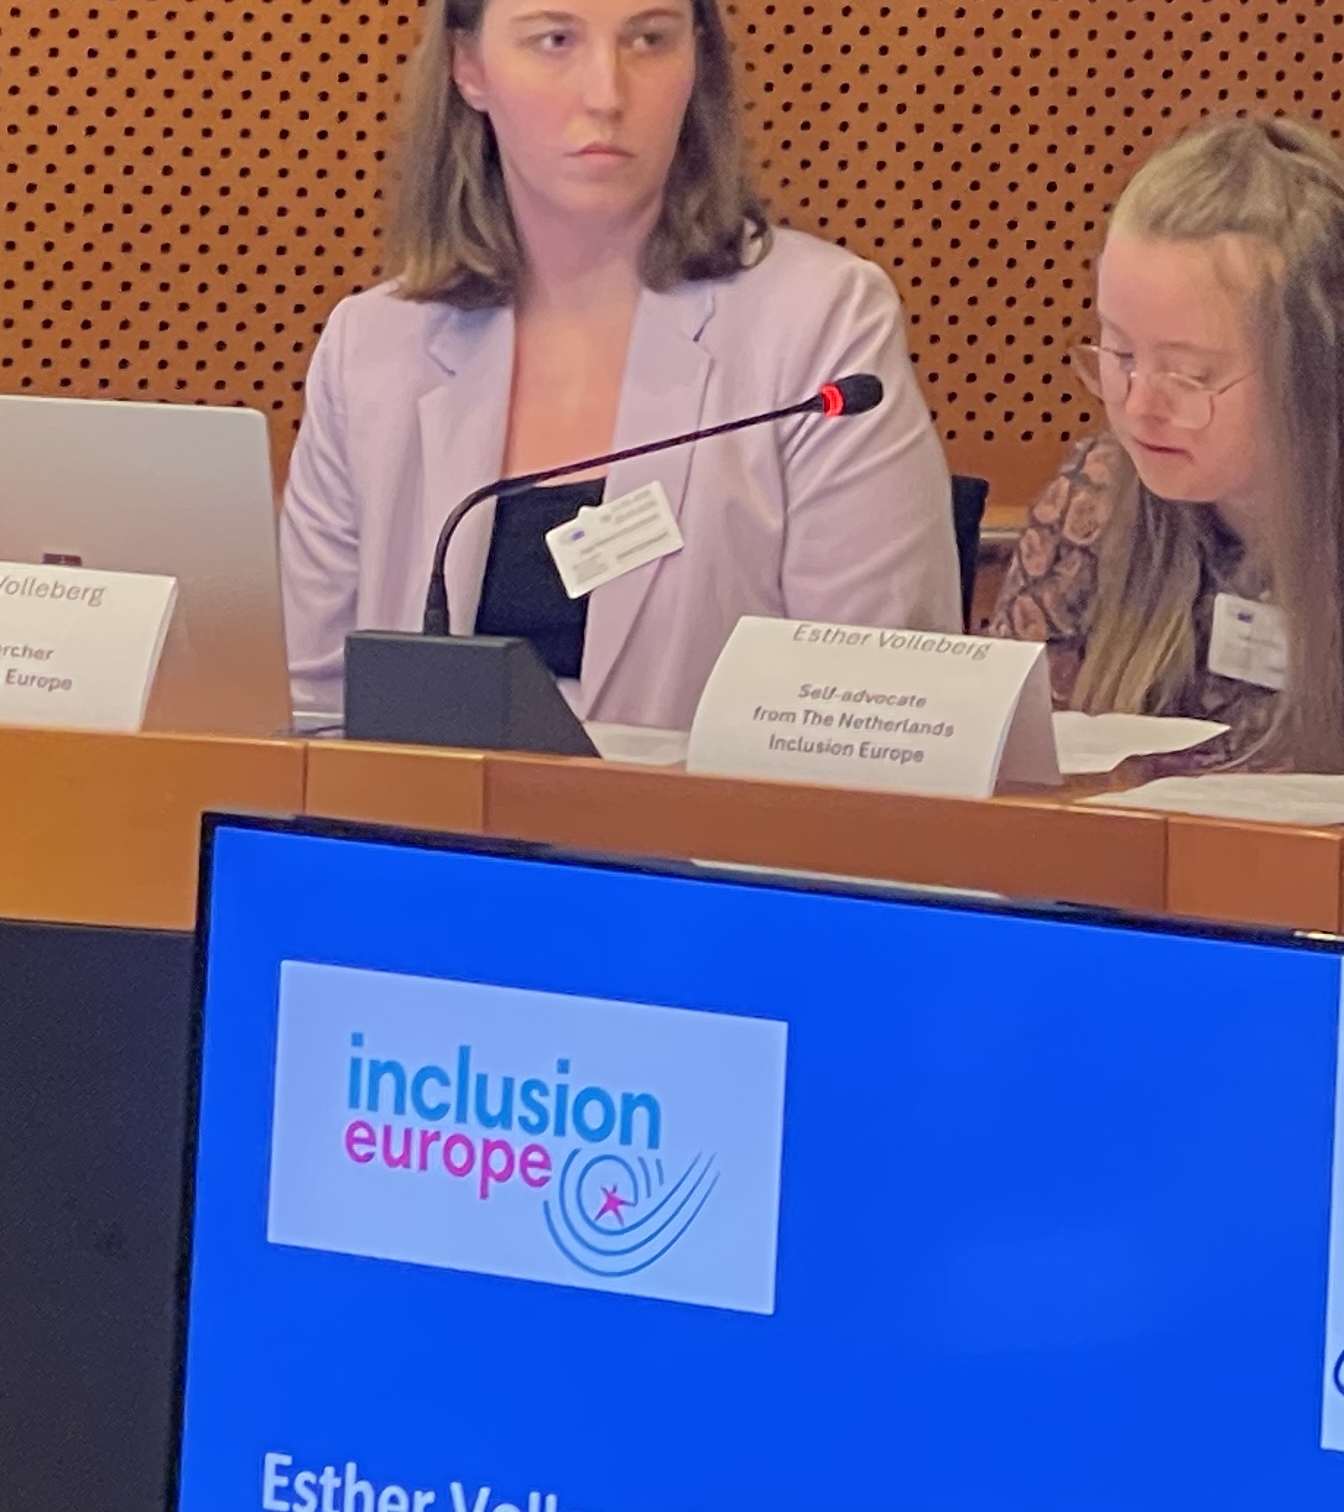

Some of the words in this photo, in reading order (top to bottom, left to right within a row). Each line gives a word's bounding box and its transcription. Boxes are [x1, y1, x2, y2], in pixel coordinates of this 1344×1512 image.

[792, 623, 871, 647] Esther
[877, 631, 993, 661] Volleberg
[6, 668, 73, 693] Europe
[798, 684, 927, 708] Self-advocate
[753, 705, 796, 725] from
[802, 709, 834, 728] The
[838, 713, 954, 738] Netherlands
[768, 734, 854, 757] Inclusion
[858, 741, 925, 764] Europe
[347, 1032, 662, 1150] inclusion
[344, 1119, 553, 1200] europe
